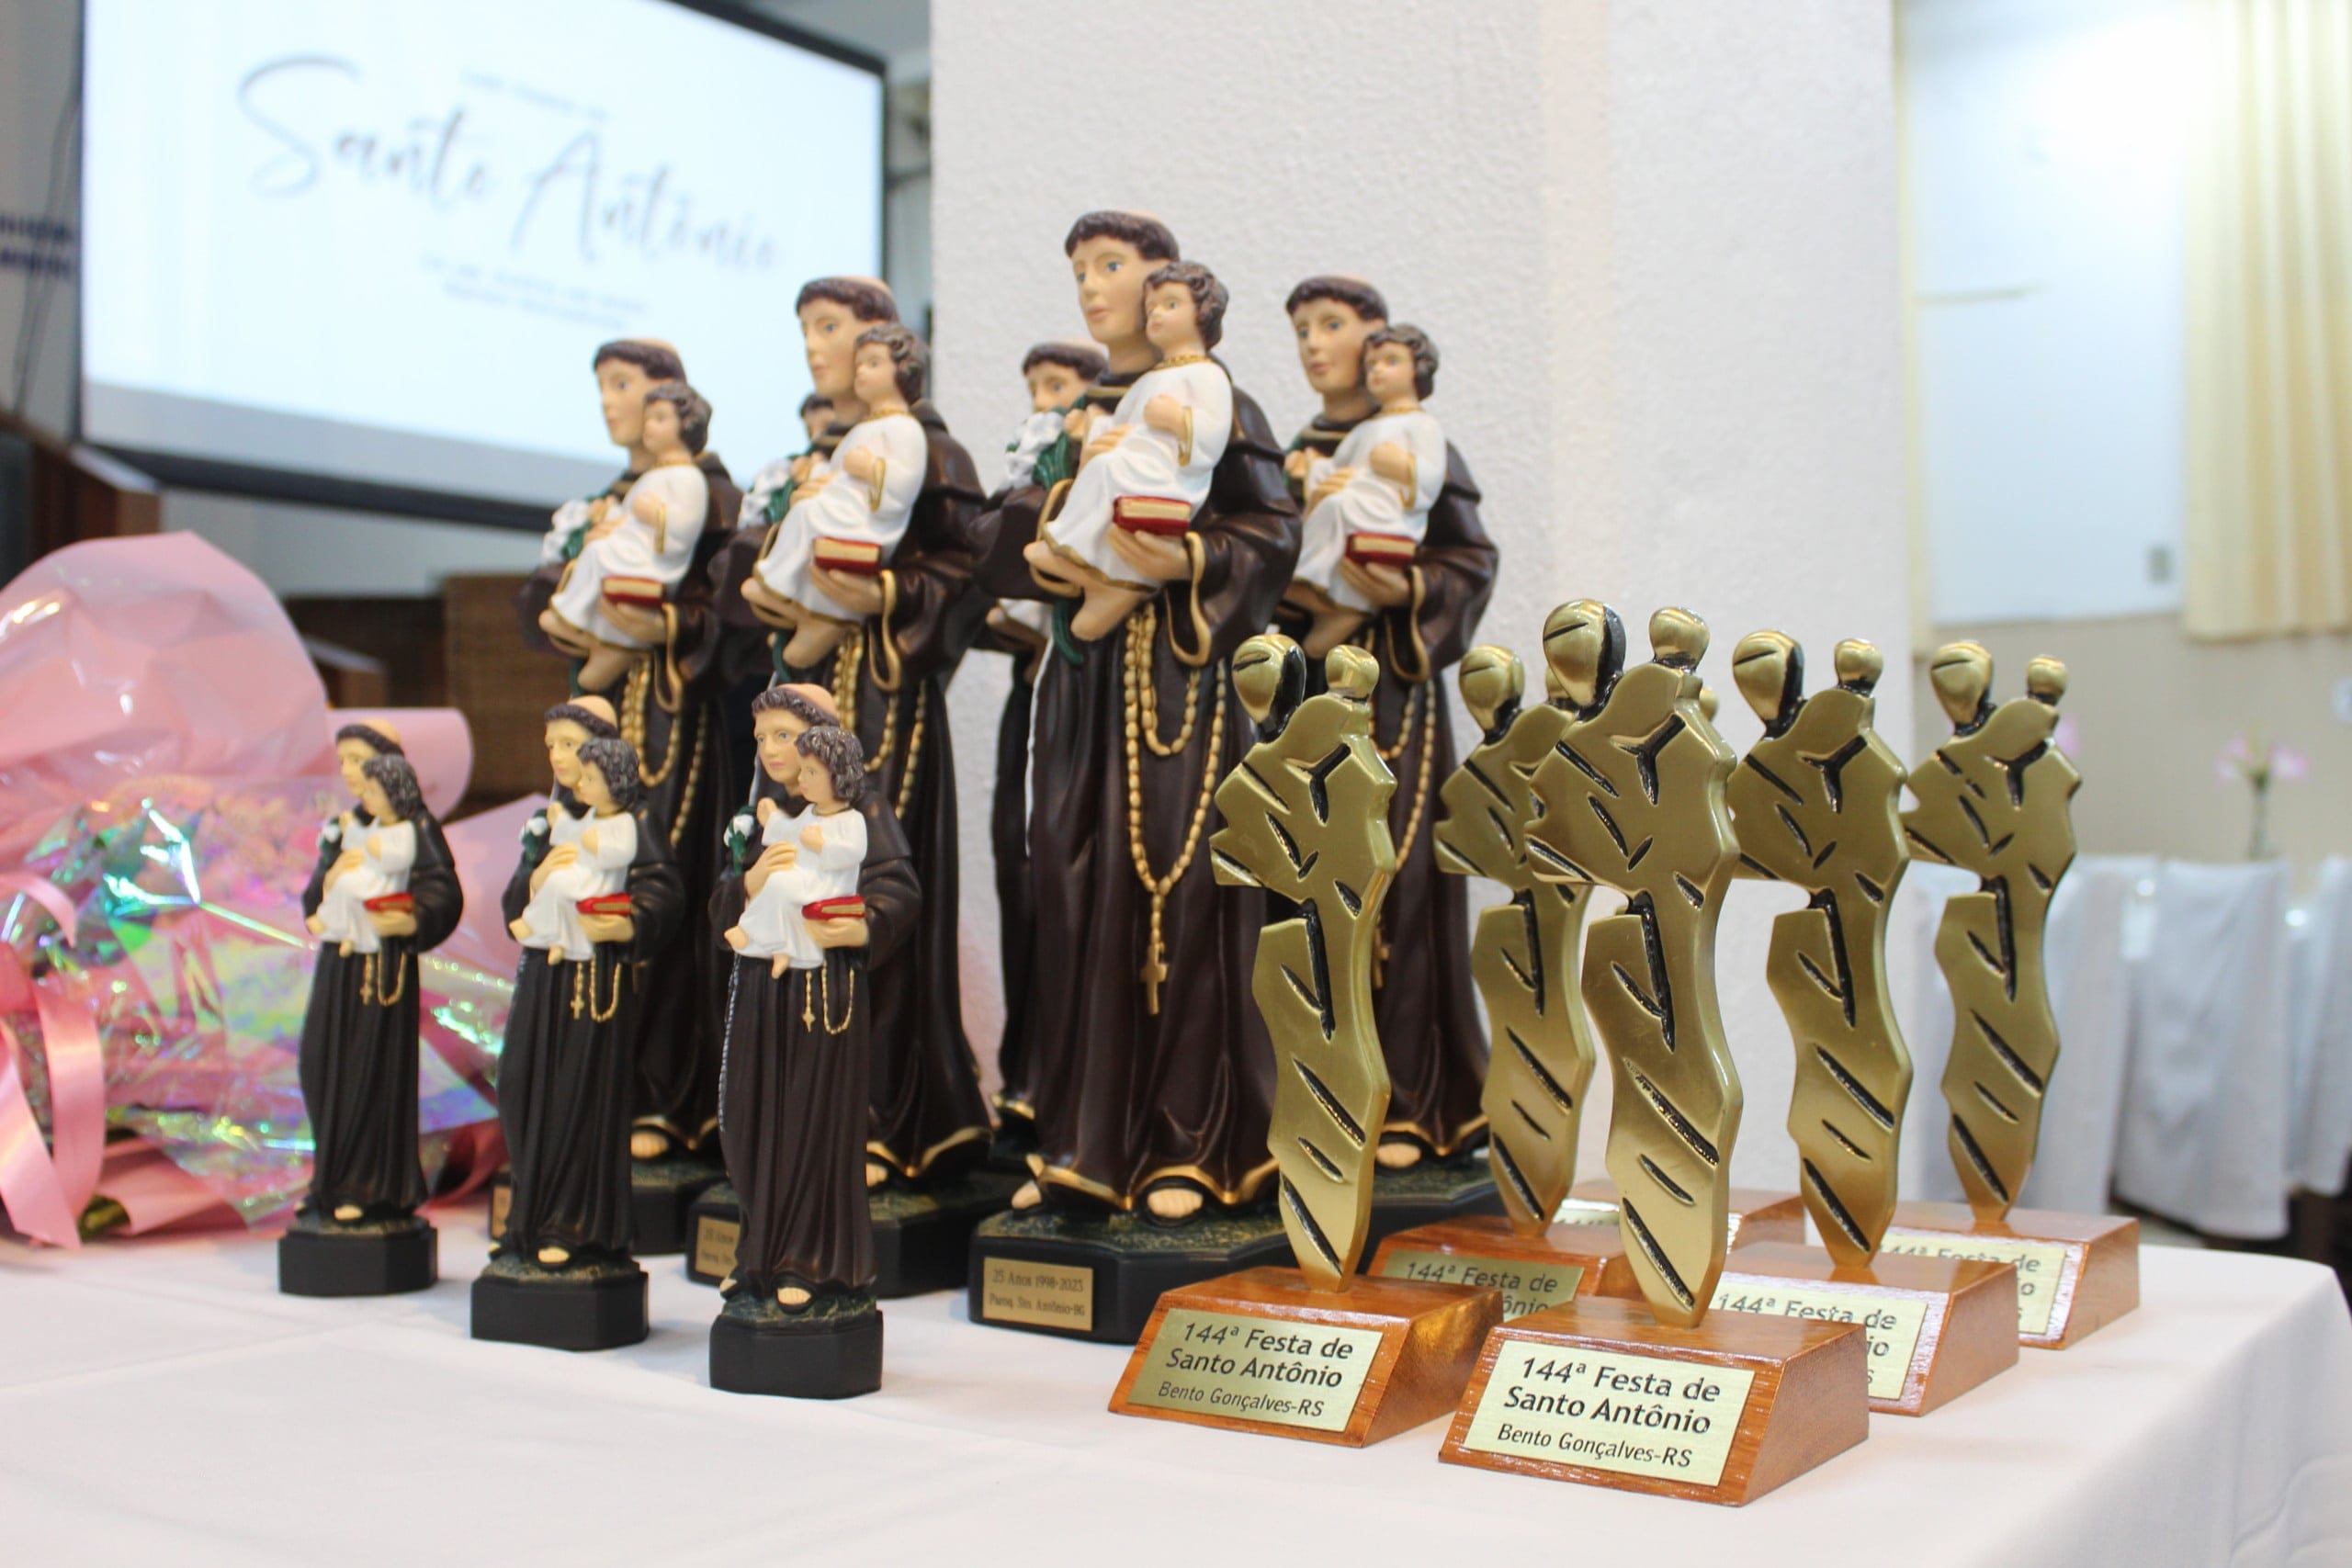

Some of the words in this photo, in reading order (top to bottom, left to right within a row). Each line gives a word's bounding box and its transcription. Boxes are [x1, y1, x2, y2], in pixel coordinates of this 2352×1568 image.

[1462, 1267, 1520, 1291] Festa
[1529, 1273, 1558, 1293] de
[2011, 1254, 2041, 1272] de
[1784, 1300, 1853, 1324] Festa
[1863, 1308, 1897, 1330] de
[1183, 1323, 1239, 1346] 144ª
[1244, 1328, 1312, 1356] Festa
[1320, 1337, 1353, 1360] de
[1165, 1348, 1236, 1375] Santo
[1239, 1357, 1342, 1388] Antônio
[1521, 1357, 1587, 1384] 144ª
[1593, 1365, 1671, 1397] Festa
[1682, 1375, 1721, 1403] de
[1158, 1381, 1204, 1404] Bento
[1210, 1388, 1325, 1418] Gonçalves-RS
[1503, 1385, 1585, 1418] Santo
[1591, 1395, 1712, 1435] Antônio
[1497, 1423, 1552, 1449] Bento
[1558, 1431, 1693, 1469] Gonçalves-RS
